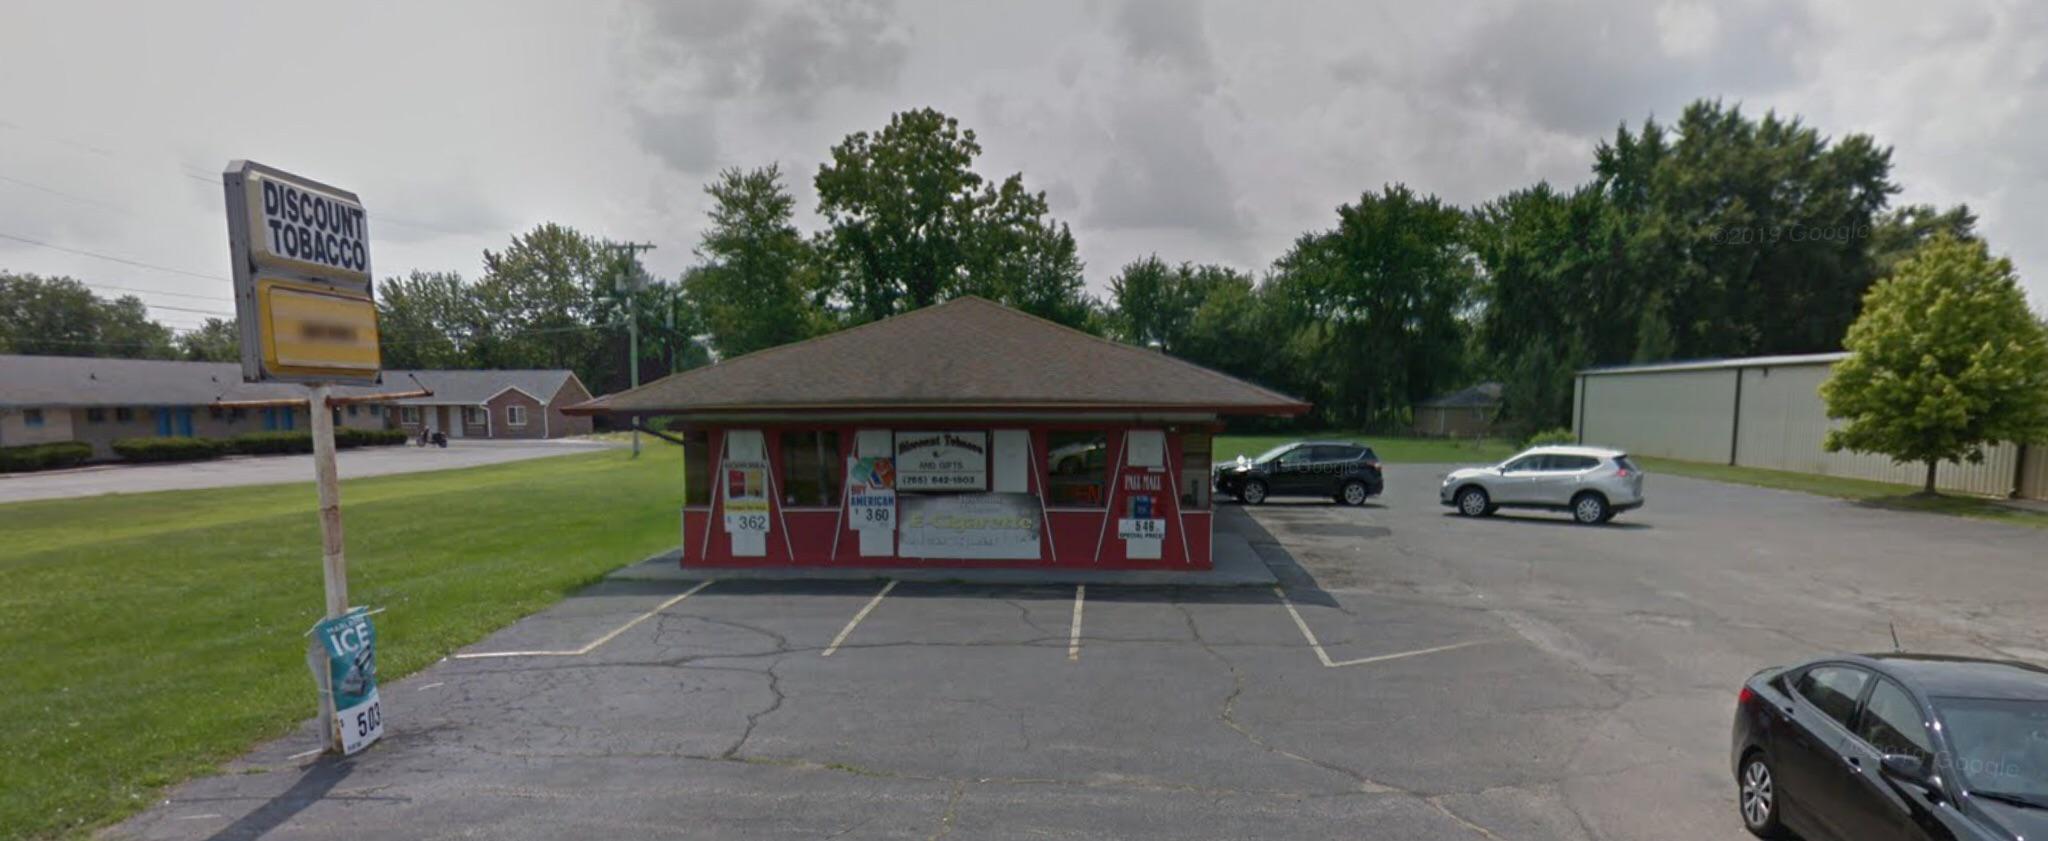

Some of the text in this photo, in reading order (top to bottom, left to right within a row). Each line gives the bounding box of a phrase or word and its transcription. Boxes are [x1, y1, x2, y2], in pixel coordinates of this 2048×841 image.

[263, 180, 363, 240] DISCOUNT
[268, 219, 366, 272] TOBACCO
[851, 496, 894, 507] AMERICAN
[866, 508, 889, 521] 360
[739, 515, 766, 530] 362
[330, 622, 370, 657] ICE
[357, 702, 381, 737] 503
